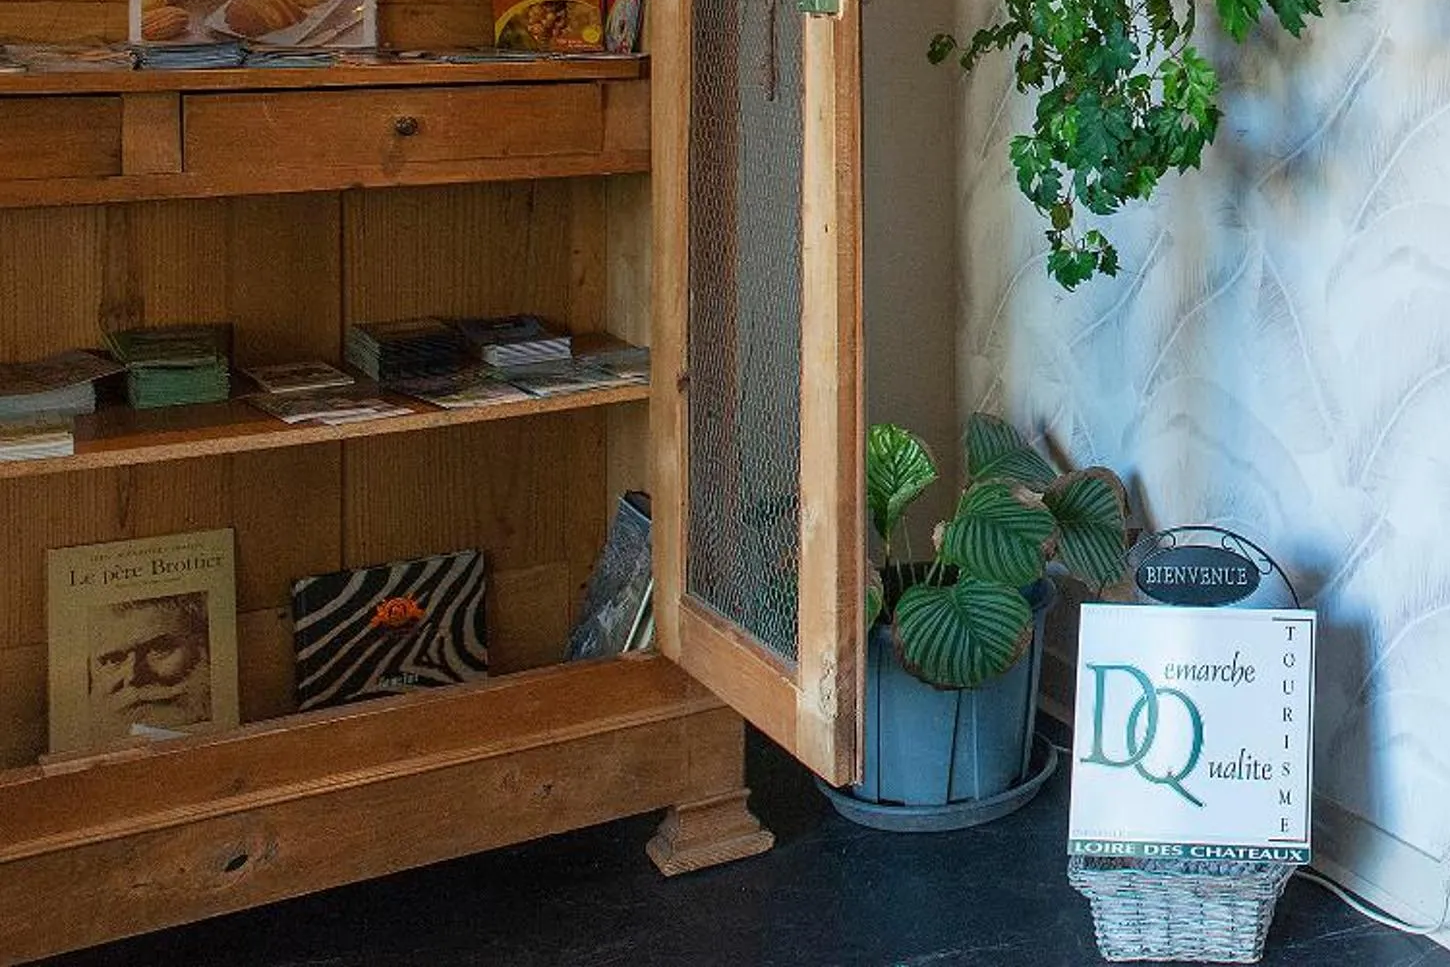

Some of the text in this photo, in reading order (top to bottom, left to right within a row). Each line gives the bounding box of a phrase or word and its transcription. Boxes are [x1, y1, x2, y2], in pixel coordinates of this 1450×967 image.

[70, 569, 95, 587] Le
[103, 564, 143, 584] père
[1146, 564, 1249, 586] BIENVENUE
[1279, 626, 1296, 833] TOURISME
[1074, 842, 1304, 862] LOIRE DES CHATEAUX
